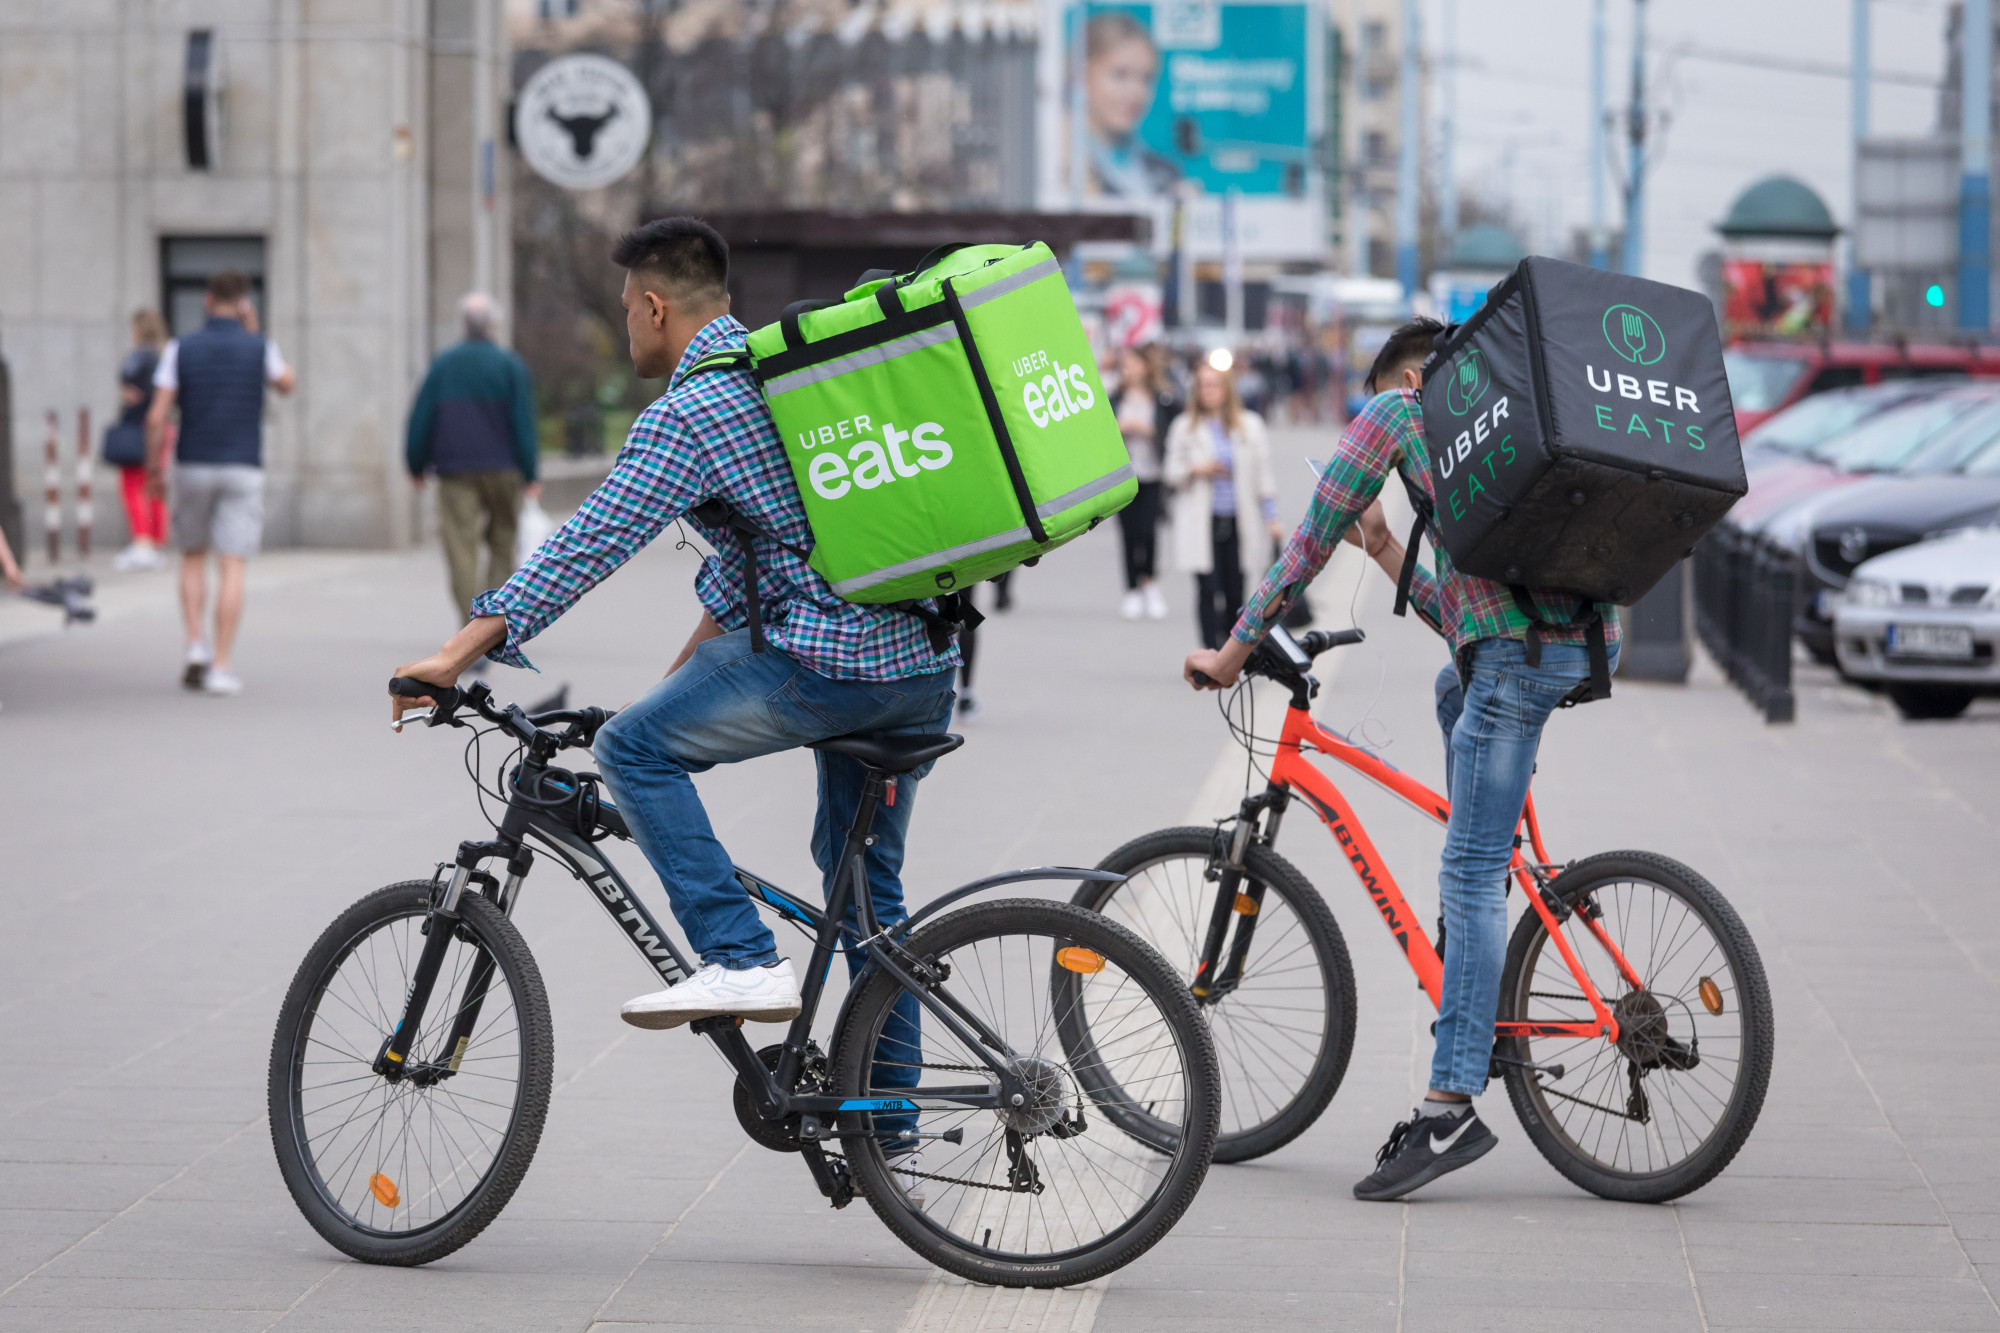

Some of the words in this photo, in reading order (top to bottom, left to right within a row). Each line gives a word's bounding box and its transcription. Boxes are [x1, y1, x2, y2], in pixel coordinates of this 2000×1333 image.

[1012, 350, 1049, 378] UBER
[1023, 360, 1095, 429] eats
[1587, 365, 1701, 413] UBER
[799, 414, 873, 450] UBER
[1439, 396, 1510, 480] UBER
[1595, 405, 1705, 451] EATS
[808, 421, 953, 500] eats
[1449, 434, 1516, 521] EATS
[882, 1101, 903, 1110] MTB
